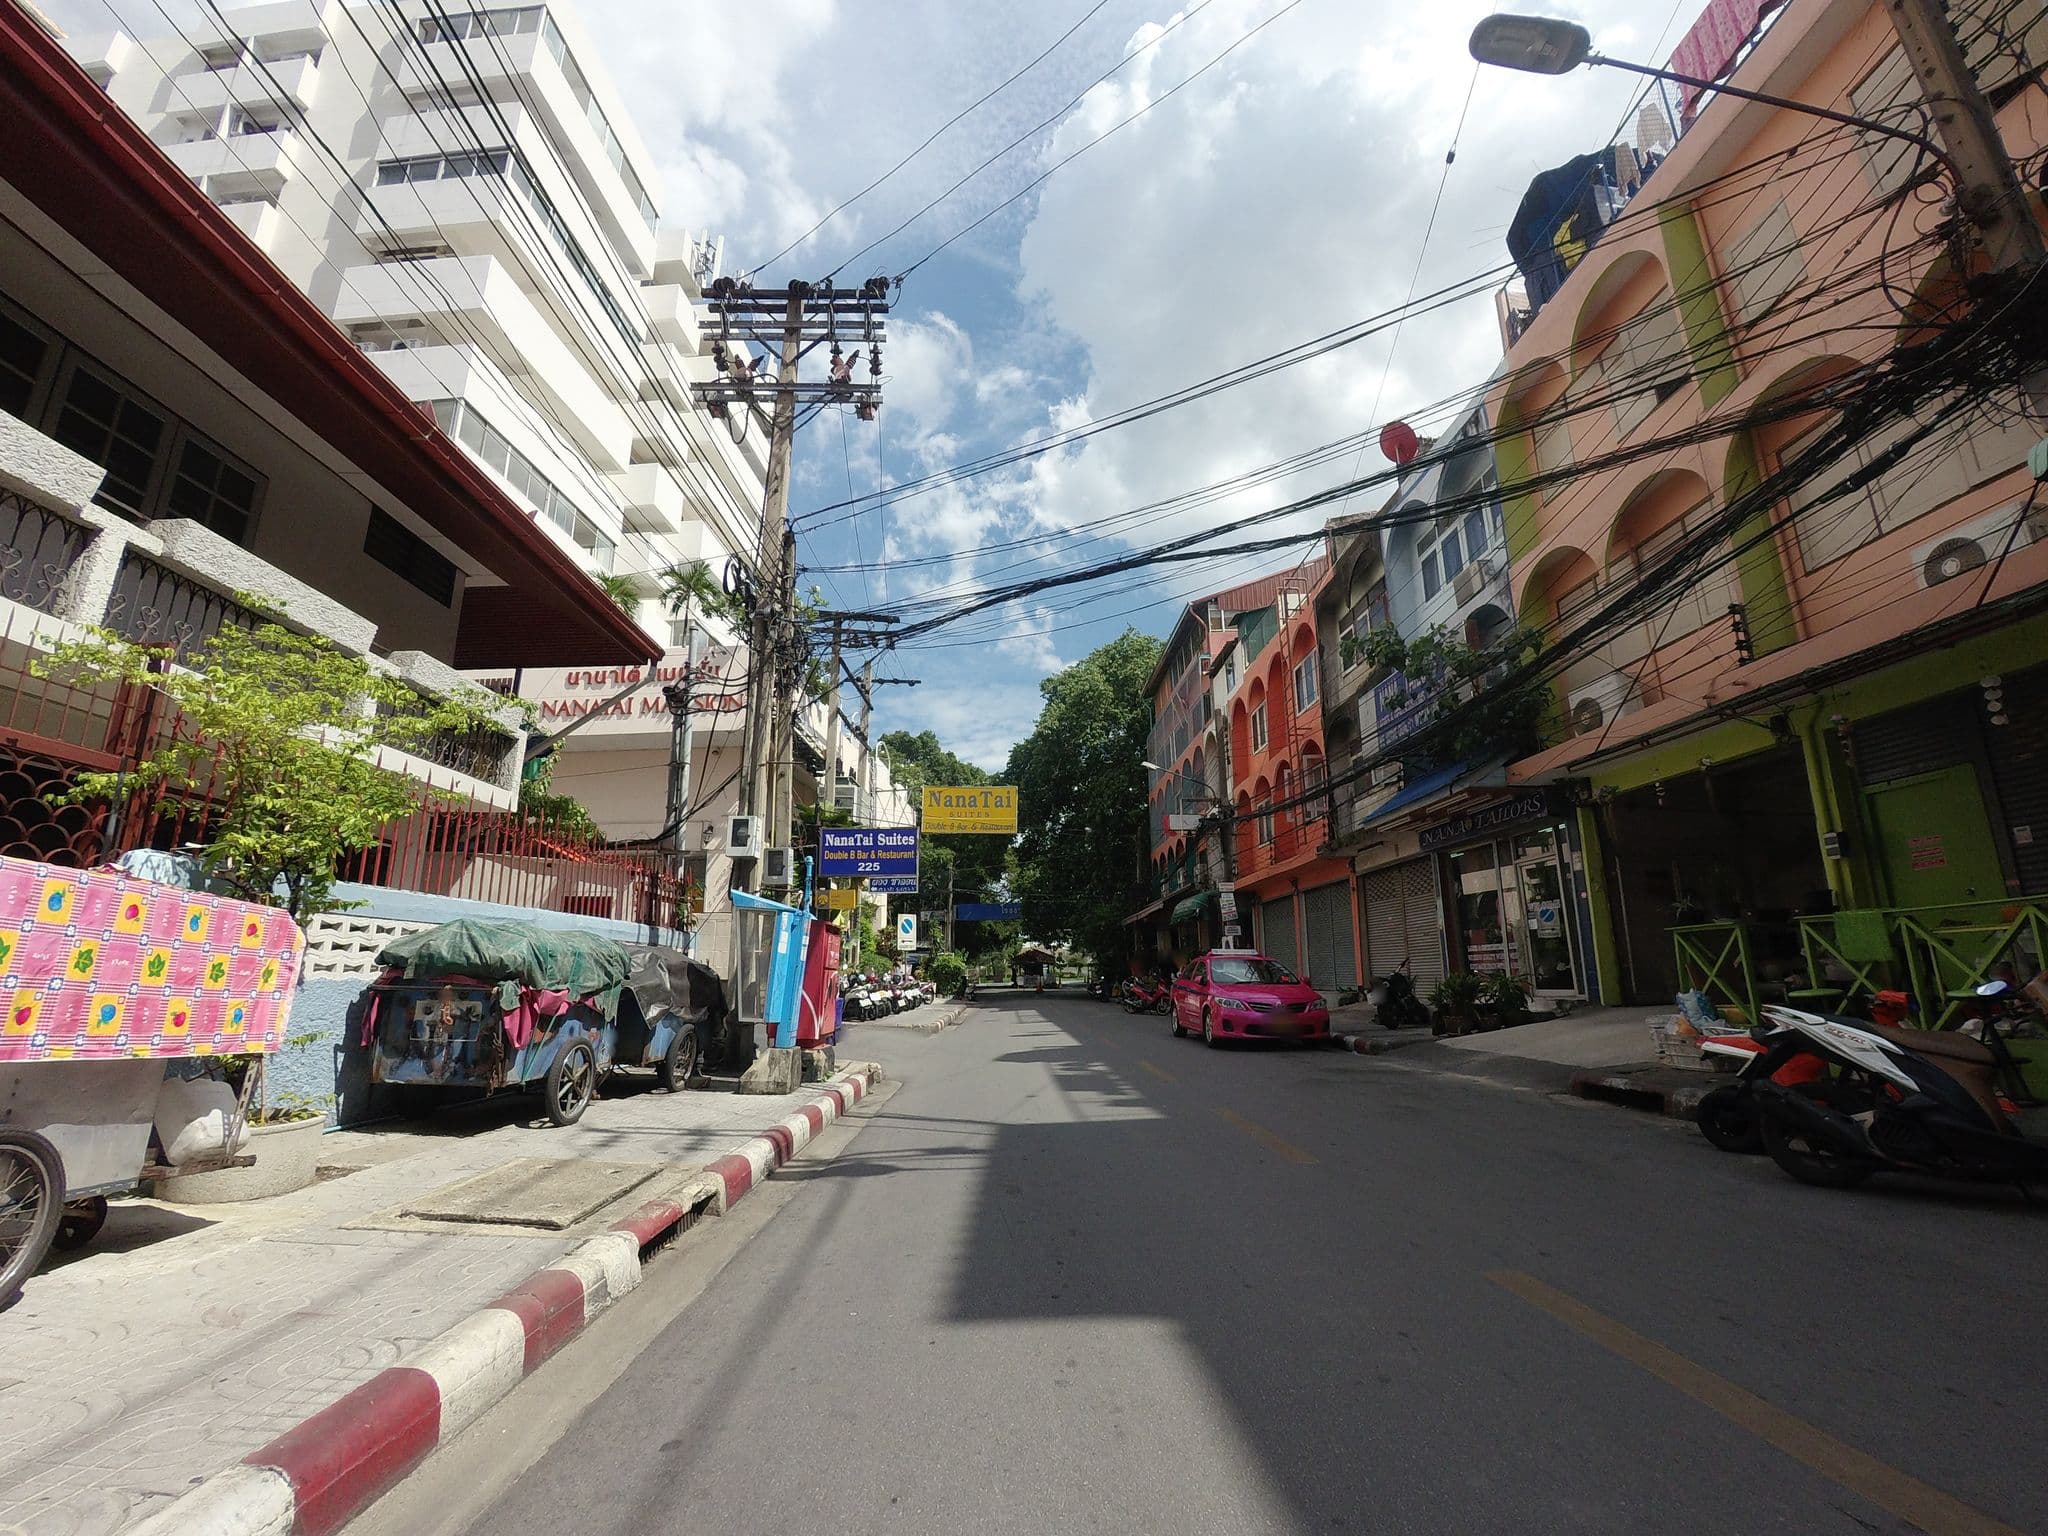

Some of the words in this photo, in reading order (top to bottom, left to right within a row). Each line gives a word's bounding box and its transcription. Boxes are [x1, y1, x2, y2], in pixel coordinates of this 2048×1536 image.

[541, 696, 634, 718] NANATAI
[641, 694, 744, 715] MSION
[928, 790, 1012, 809] NanaTai
[1475, 793, 1542, 830] TAILORS
[824, 833, 873, 847] NanaTai
[877, 832, 915, 846] Suites
[824, 850, 848, 860] Double
[850, 850, 855, 860] B
[857, 850, 868, 860] Bar
[870, 850, 876, 859] &
[877, 850, 915, 859] Restaurant
[857, 862, 880, 871] 225
